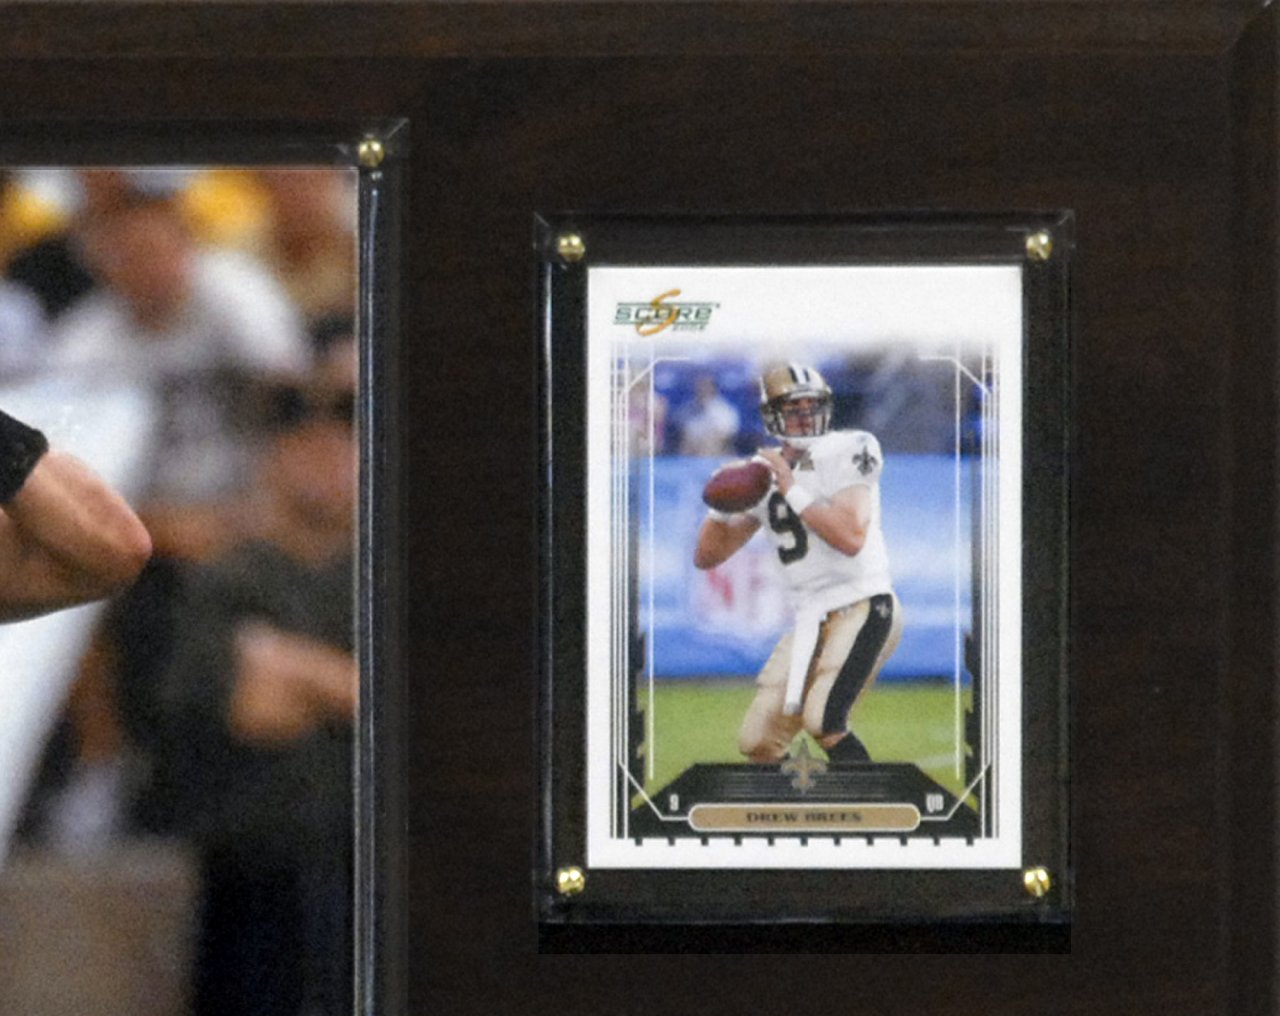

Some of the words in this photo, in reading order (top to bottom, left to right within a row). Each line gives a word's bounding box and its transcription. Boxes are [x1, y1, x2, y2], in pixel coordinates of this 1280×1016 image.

[614, 305, 714, 322] SCORE
[767, 490, 809, 565] 9
[746, 812, 797, 822] DREW
[804, 812, 862, 822] BREES
